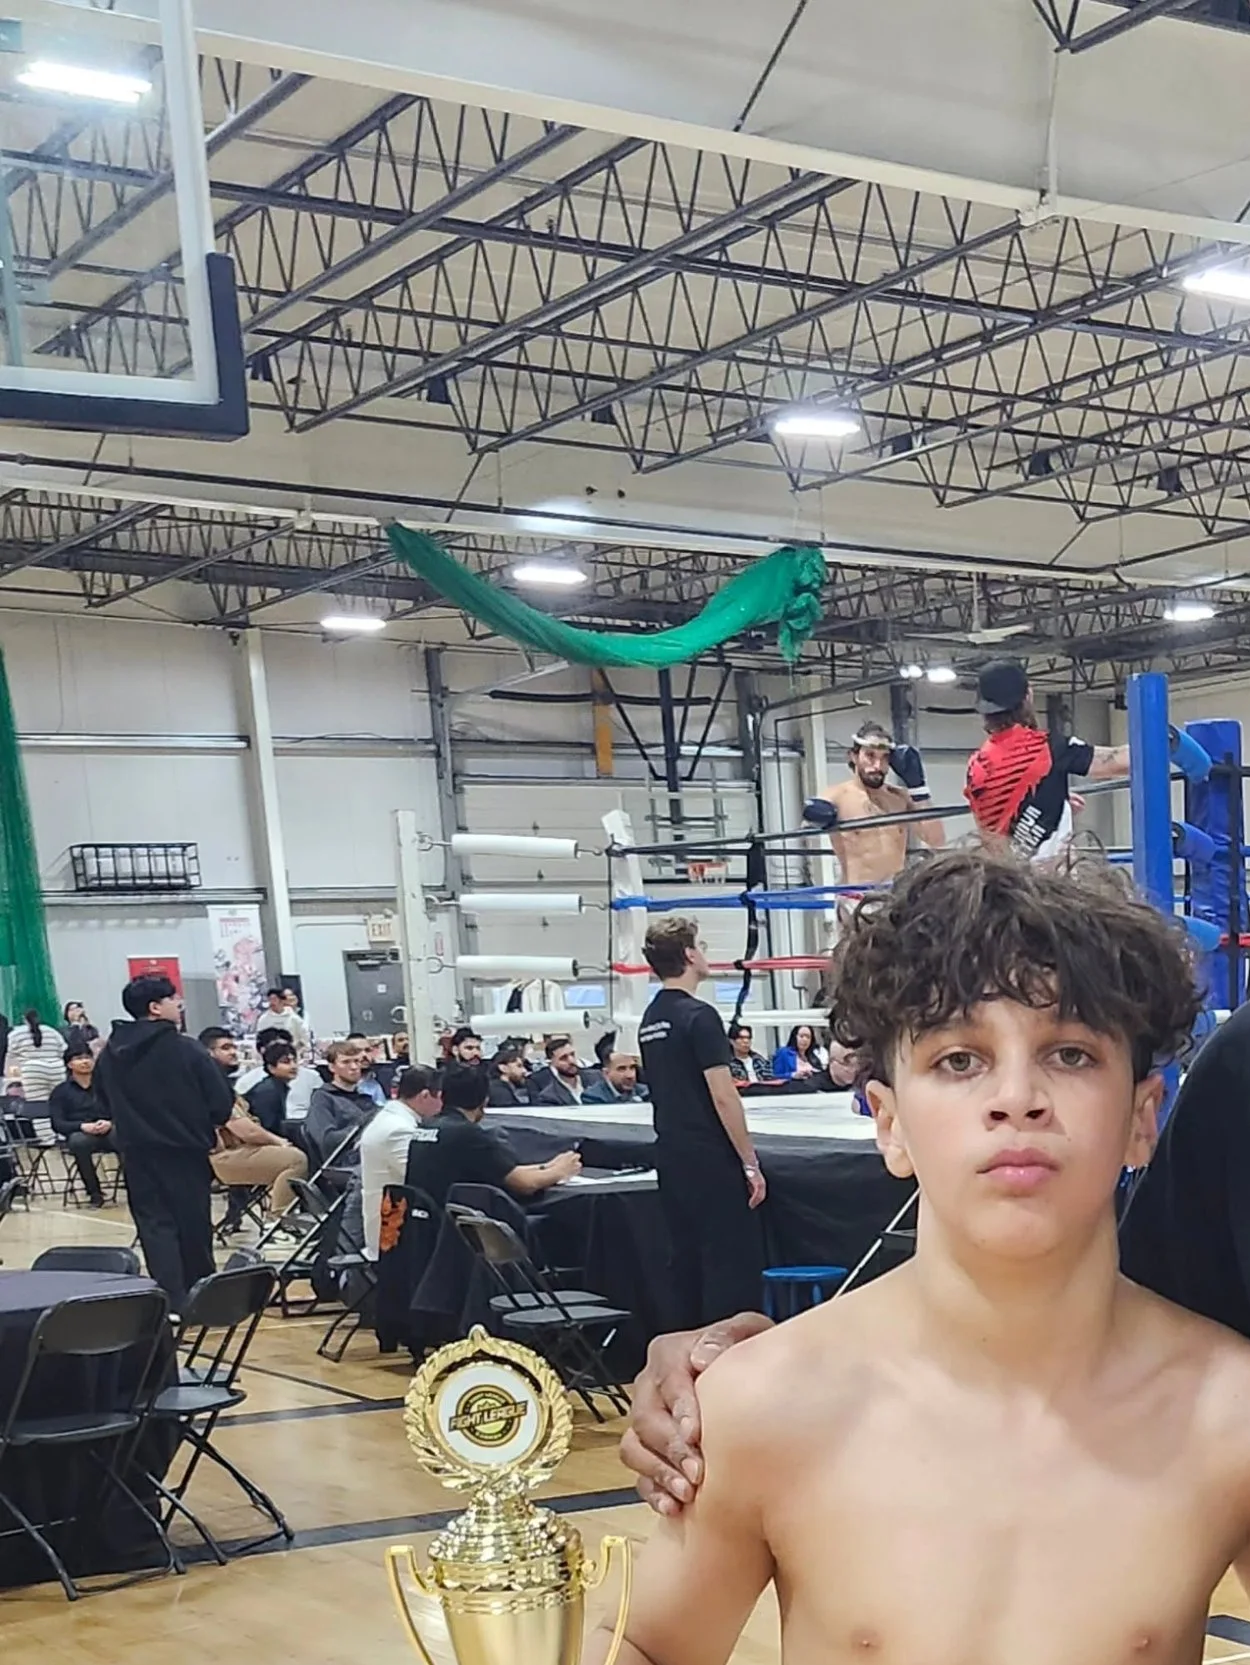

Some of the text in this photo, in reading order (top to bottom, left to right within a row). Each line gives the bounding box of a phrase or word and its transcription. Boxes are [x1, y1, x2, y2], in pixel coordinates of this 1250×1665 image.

[371, 923, 392, 937] EXIT
[449, 1401, 527, 1430] FIGHT LEAGUE
